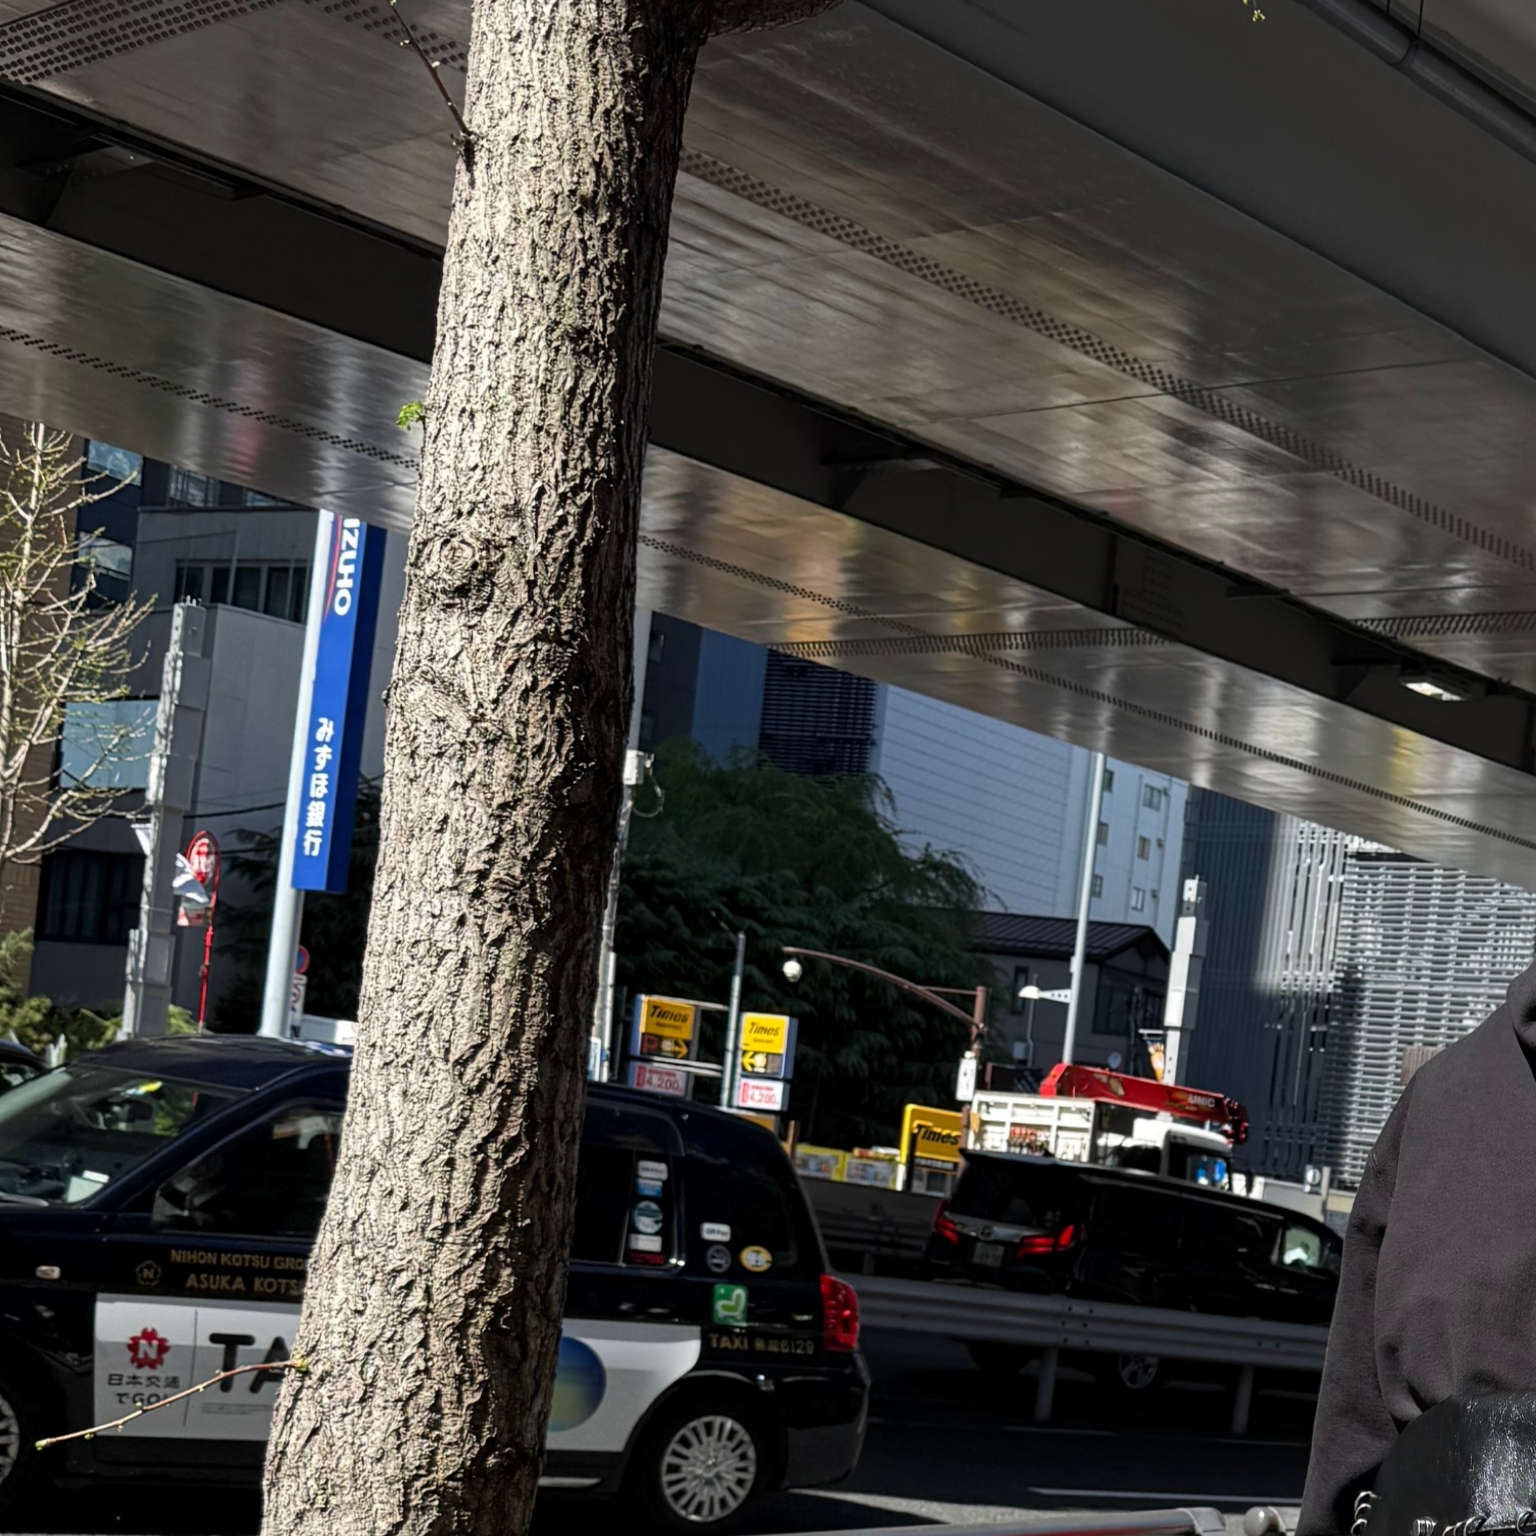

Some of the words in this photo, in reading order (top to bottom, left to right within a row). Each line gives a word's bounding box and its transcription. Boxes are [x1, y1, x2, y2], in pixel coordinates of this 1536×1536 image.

[303, 717, 334, 857] みずほ銀行
[650, 1005, 690, 1024] Times
[749, 1022, 781, 1037] Times
[913, 1120, 961, 1146] Times
[170, 1249, 218, 1265] NIHON
[220, 1252, 270, 1268] KOTSU
[185, 1273, 246, 1291] ASUKA
[707, 1333, 748, 1350] TAXI
[107, 1373, 181, 1389] 日本交通
